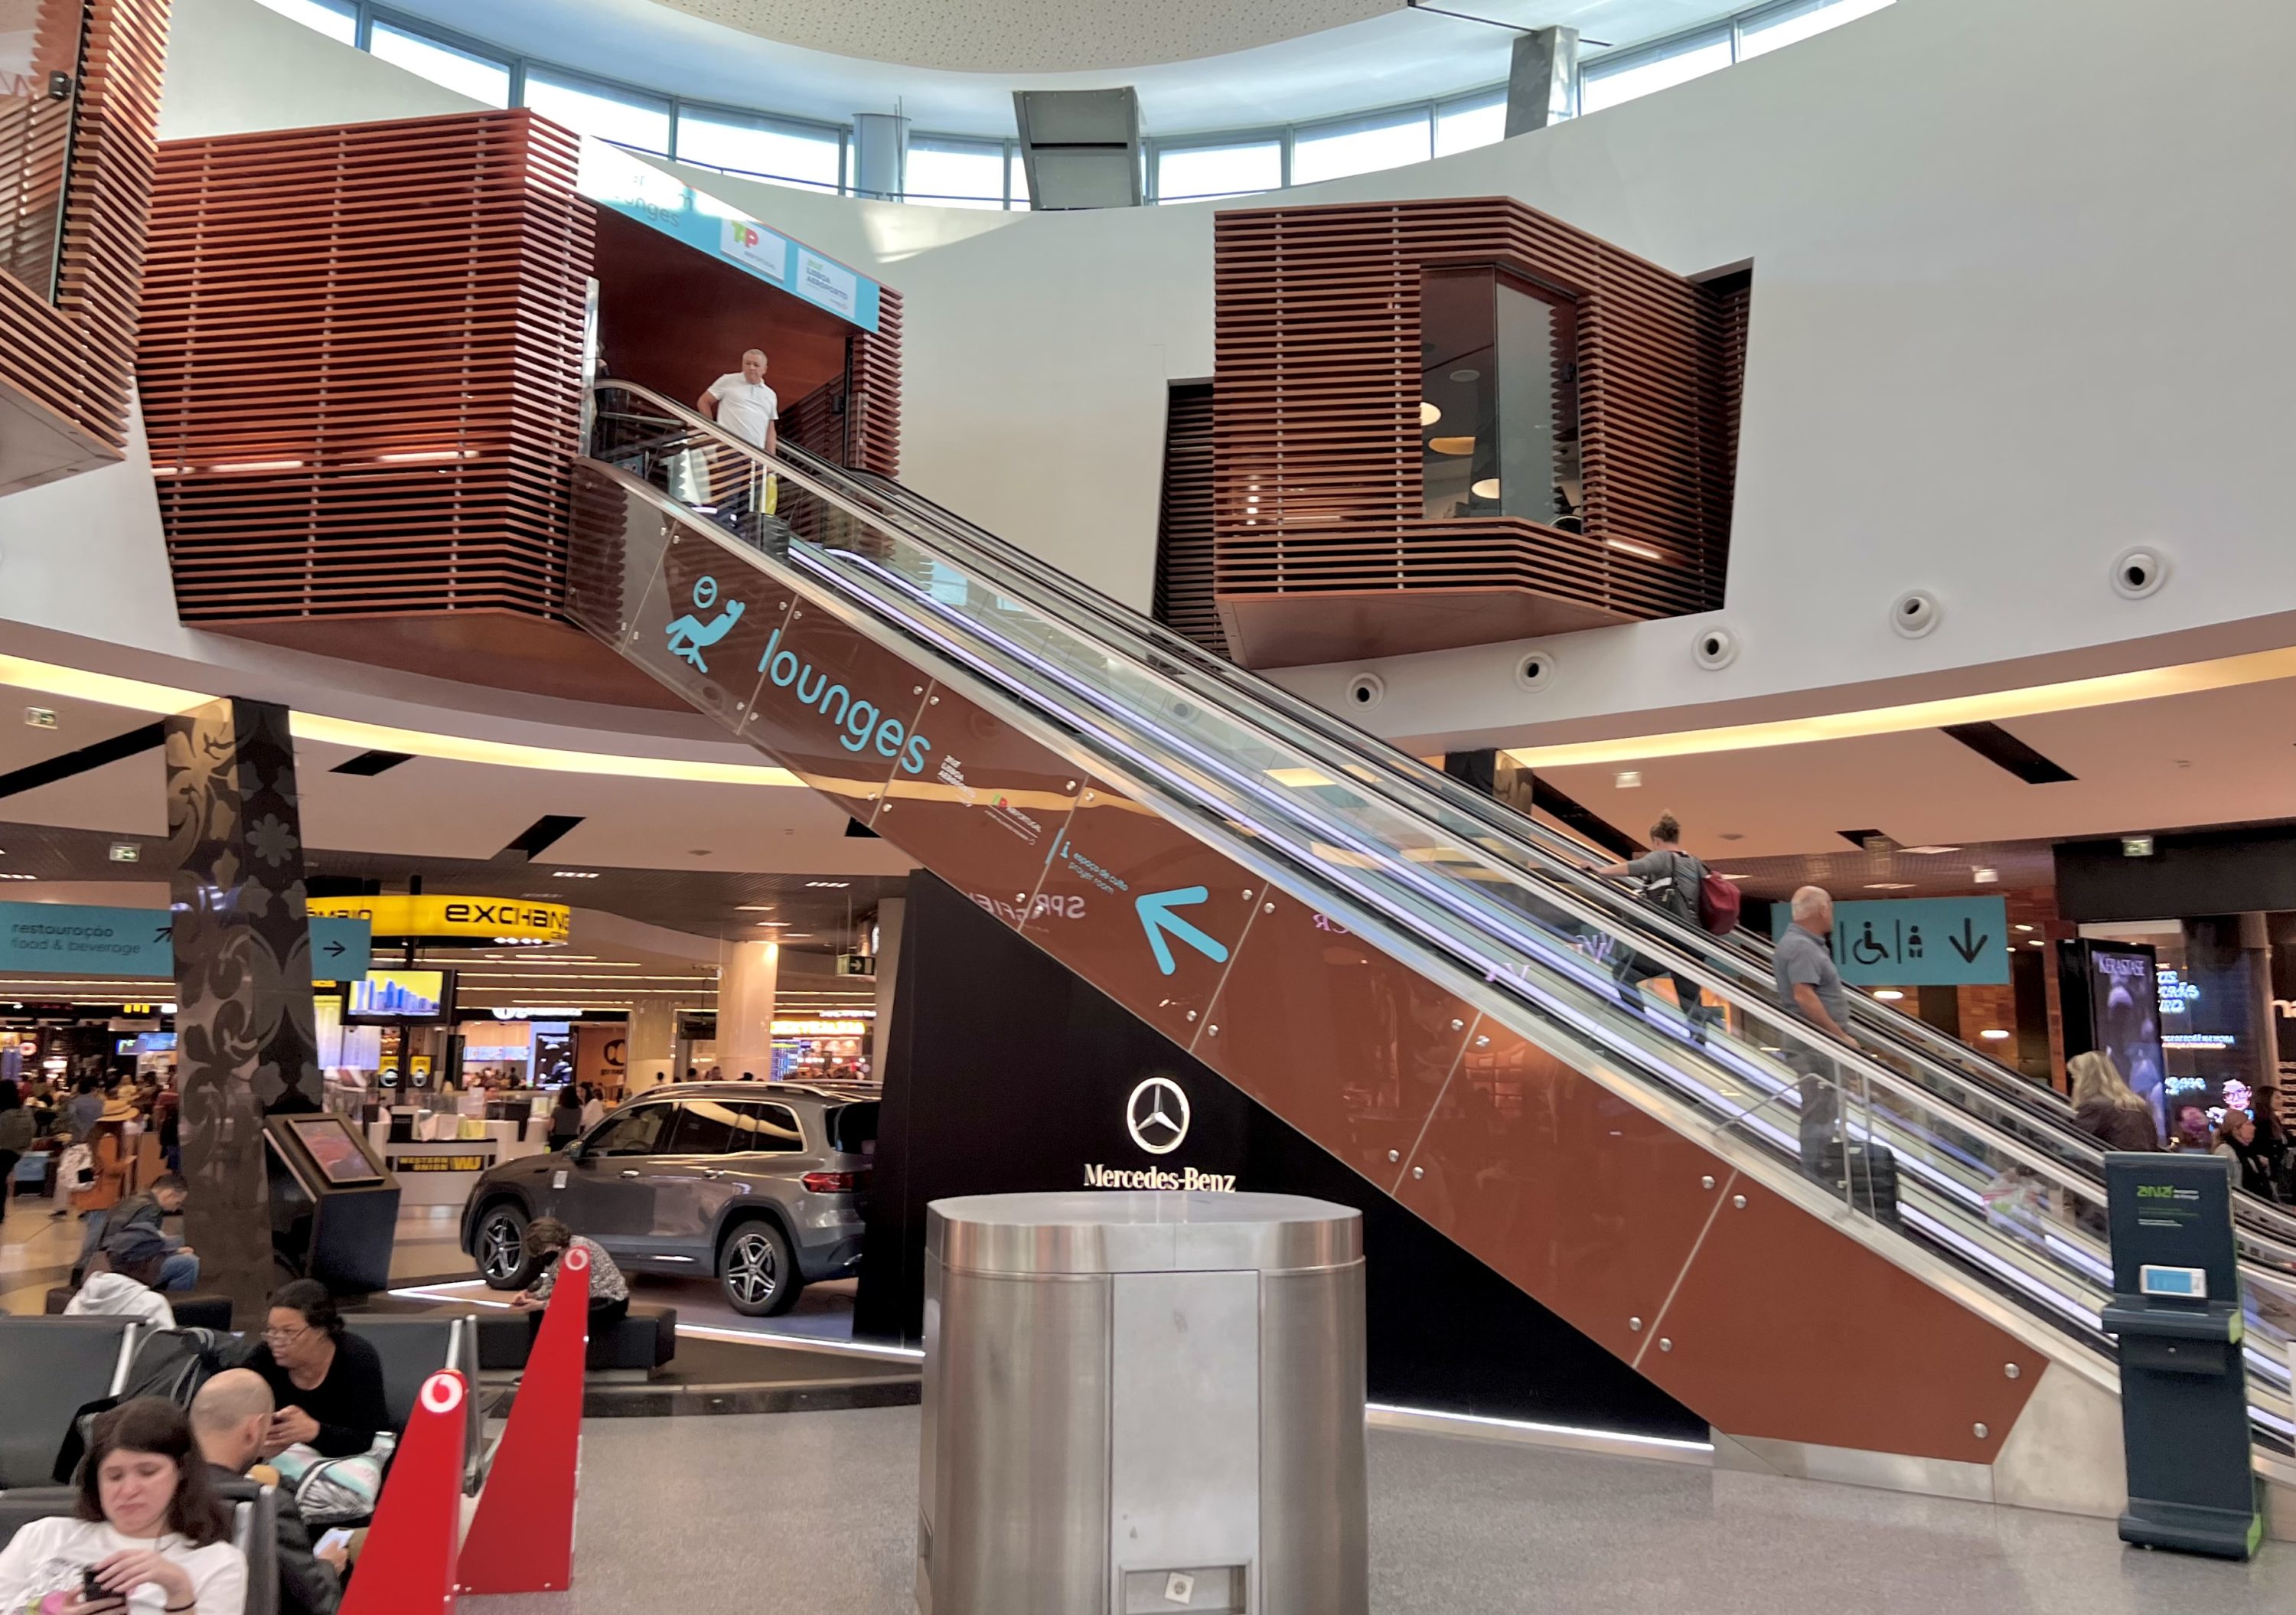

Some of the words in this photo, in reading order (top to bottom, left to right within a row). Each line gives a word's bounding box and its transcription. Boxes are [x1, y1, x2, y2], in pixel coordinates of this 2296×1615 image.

[758, 628, 931, 774] lounges
[11, 923, 114, 941] restauração
[11, 938, 50, 951] food
[53, 939, 63, 951] &
[67, 941, 142, 956] beverage
[1084, 1163, 1236, 1193] Mercedes-Benz
